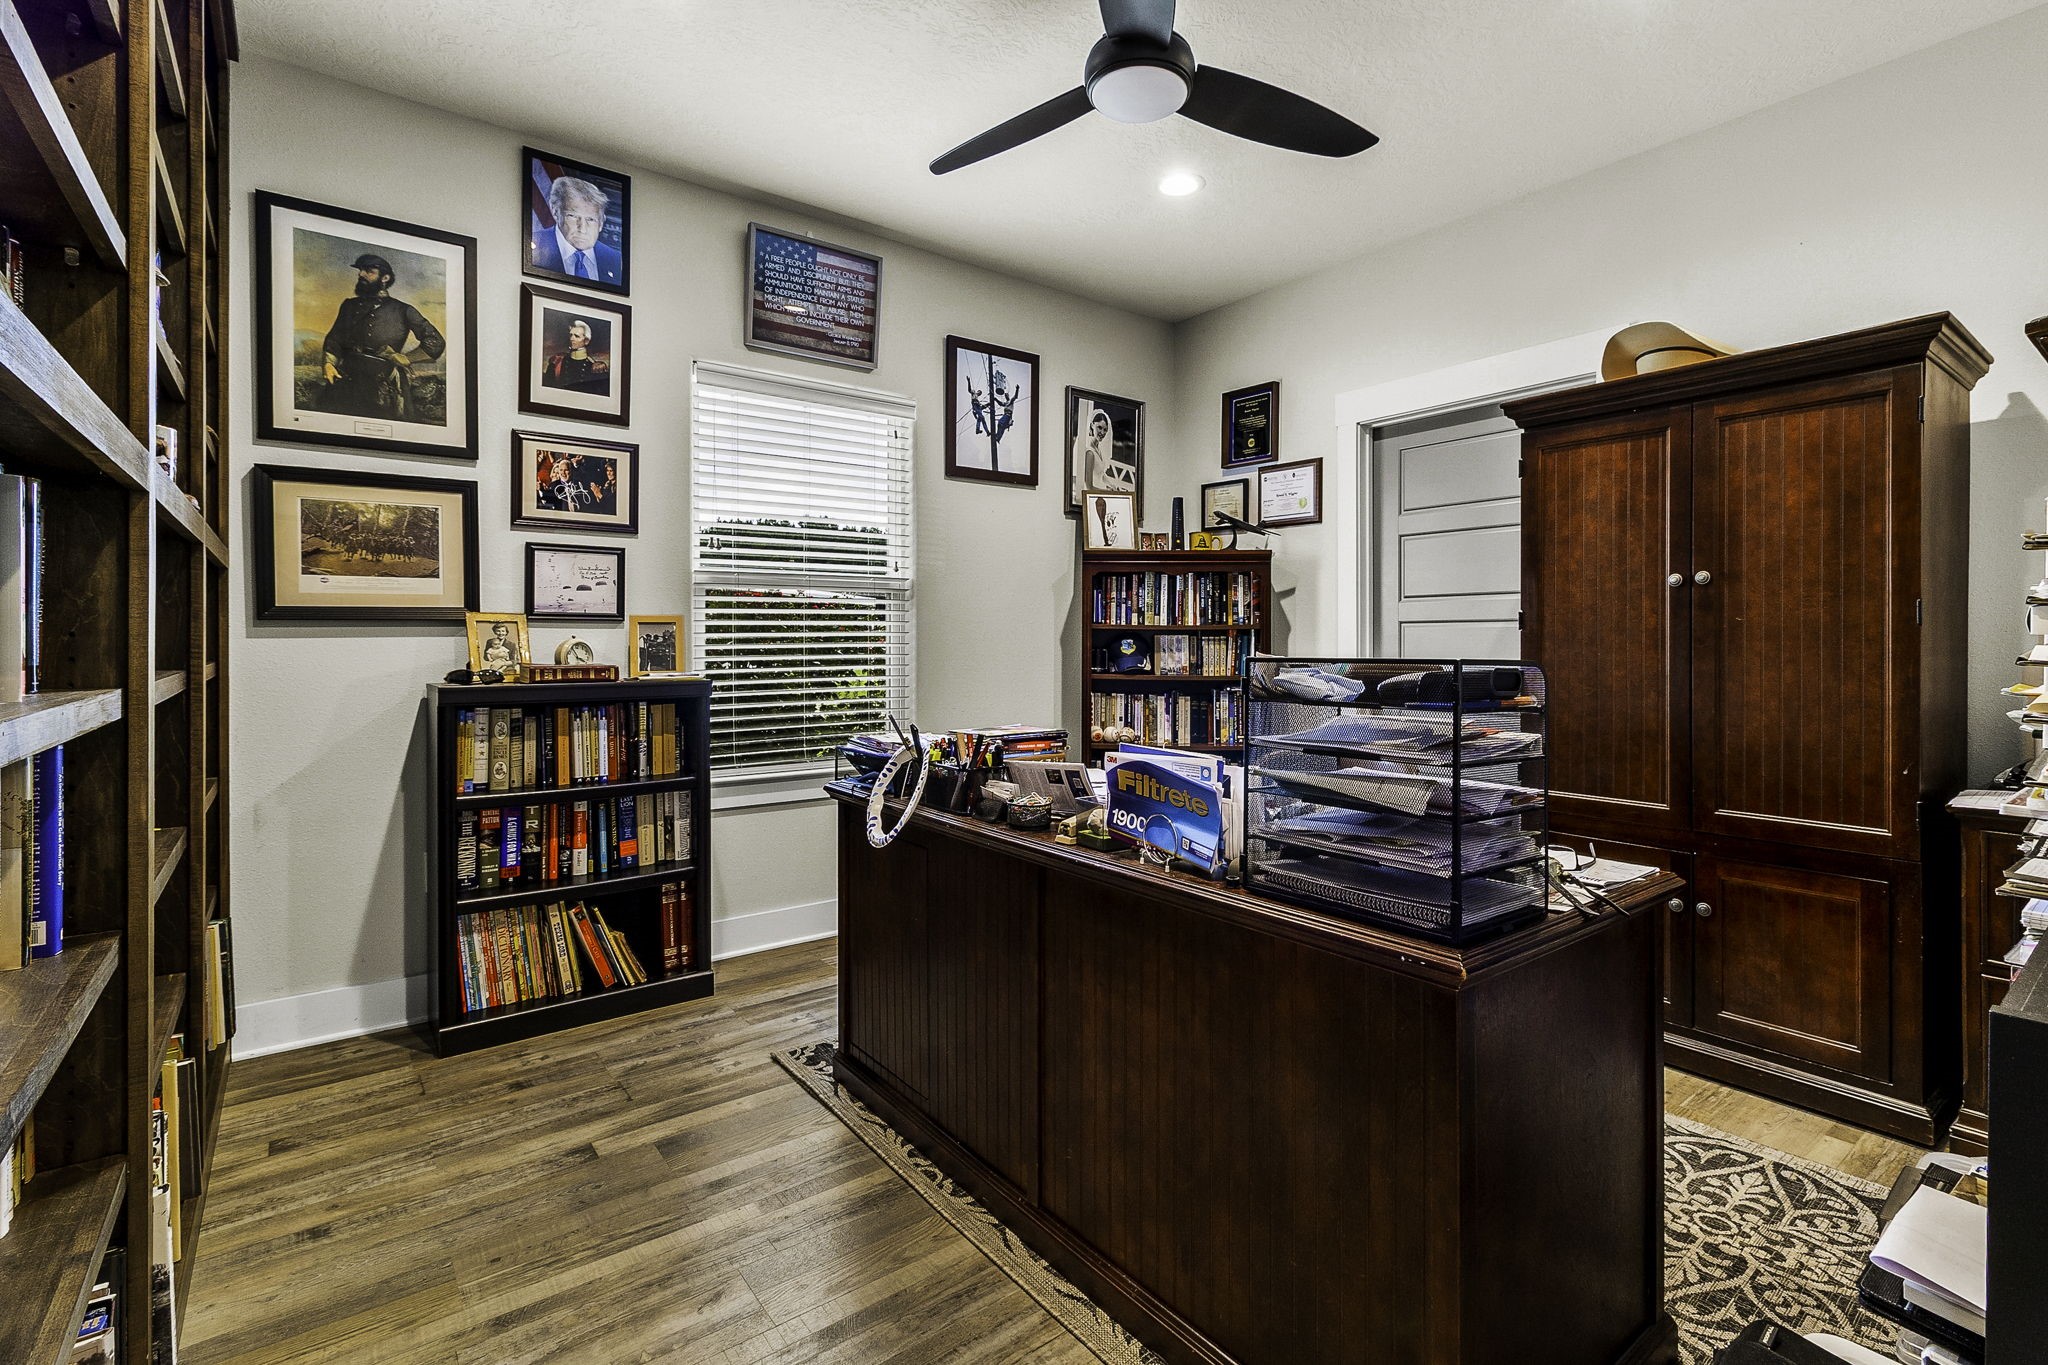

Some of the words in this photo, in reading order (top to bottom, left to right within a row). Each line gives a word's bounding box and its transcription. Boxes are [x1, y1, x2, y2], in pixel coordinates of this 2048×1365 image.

[765, 261, 784, 271] ARMED
[785, 258, 806, 268] PEOPLE
[807, 263, 828, 272] OUGHT
[764, 270, 788, 280] SHOULD
[790, 275, 804, 283] HAVE
[806, 278, 835, 290] SUFFICIENT
[837, 285, 851, 293] ARMS
[764, 278, 801, 290] AMMUNITION
[814, 288, 839, 298] MAINTAIN
[847, 295, 864, 304] STATUS
[764, 293, 782, 302] MIGHT
[788, 298, 810, 308] ATTEMPT
[828, 306, 845, 315] ABUSE
[775, 287, 817, 302] INDEPENDENCE
[819, 297, 835, 305] FROM
[764, 301, 784, 310] WHICH
[809, 310, 832, 320] INCLUDE
[1117, 769, 1209, 817] Filtrete
[525, 806, 539, 814] T
[462, 822, 472, 836] THE
[526, 820, 539, 829] R
[1112, 809, 1146, 832] 1900
[507, 822, 517, 841] GENIUS
[507, 841, 517, 852] FOR
[458, 836, 476, 879] RECKONING
[506, 852, 517, 866] WAR
[498, 926, 511, 982] DICTIONARY
